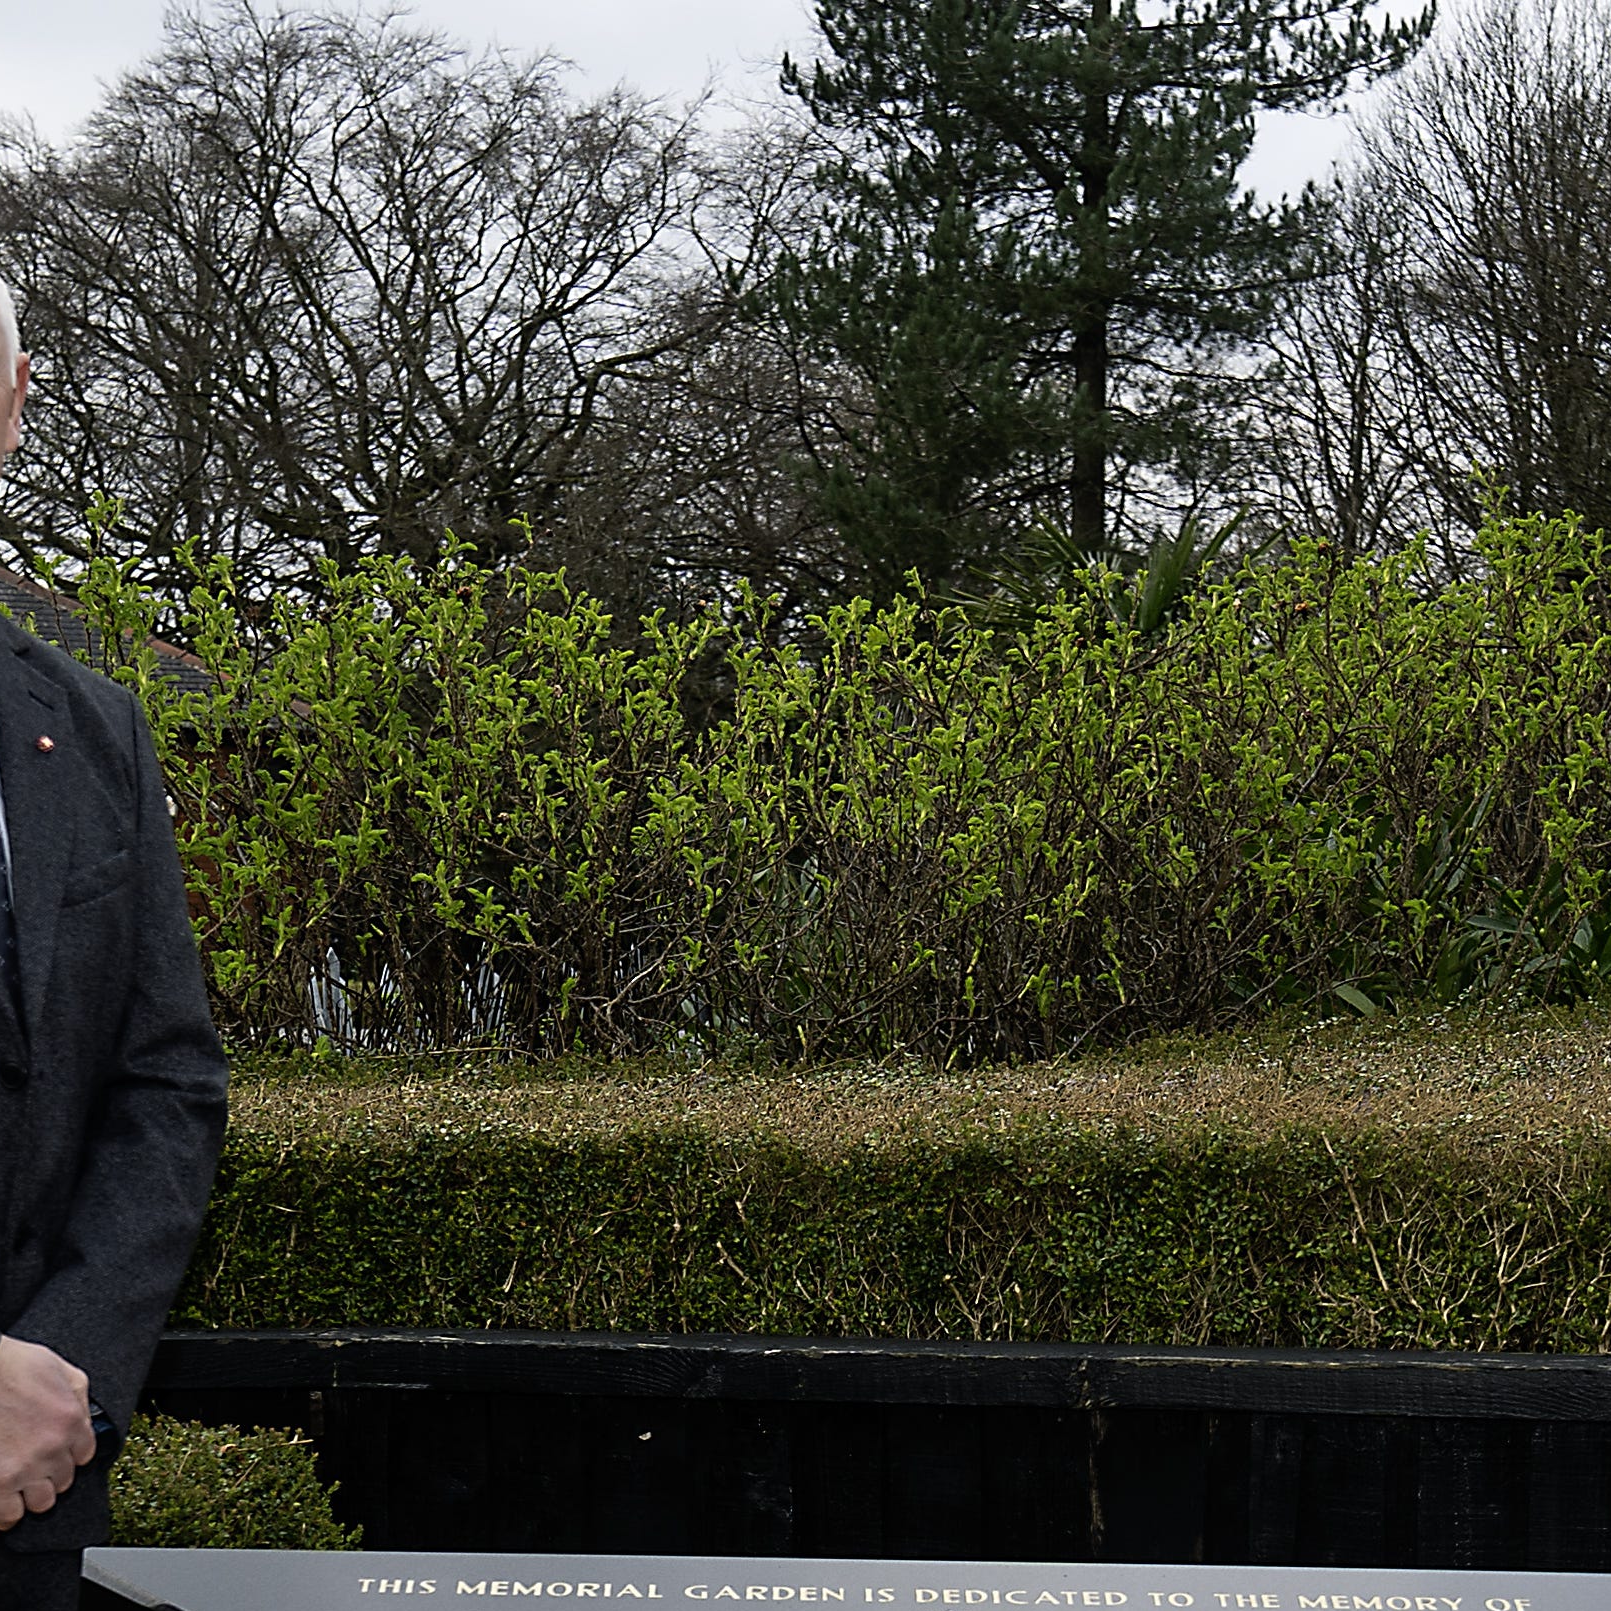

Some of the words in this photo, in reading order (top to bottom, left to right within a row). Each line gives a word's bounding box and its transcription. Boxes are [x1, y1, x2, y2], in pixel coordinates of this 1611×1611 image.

[357, 1578, 437, 1595] THIS
[456, 1580, 664, 1599] MEMORIAL
[684, 1584, 845, 1602] GARDEN
[864, 1587, 895, 1603] IS
[915, 1588, 1128, 1606] DEDICATED
[1147, 1592, 1194, 1607] TO
[1213, 1593, 1281, 1608] THE
[1298, 1595, 1463, 1611] MEMORY
